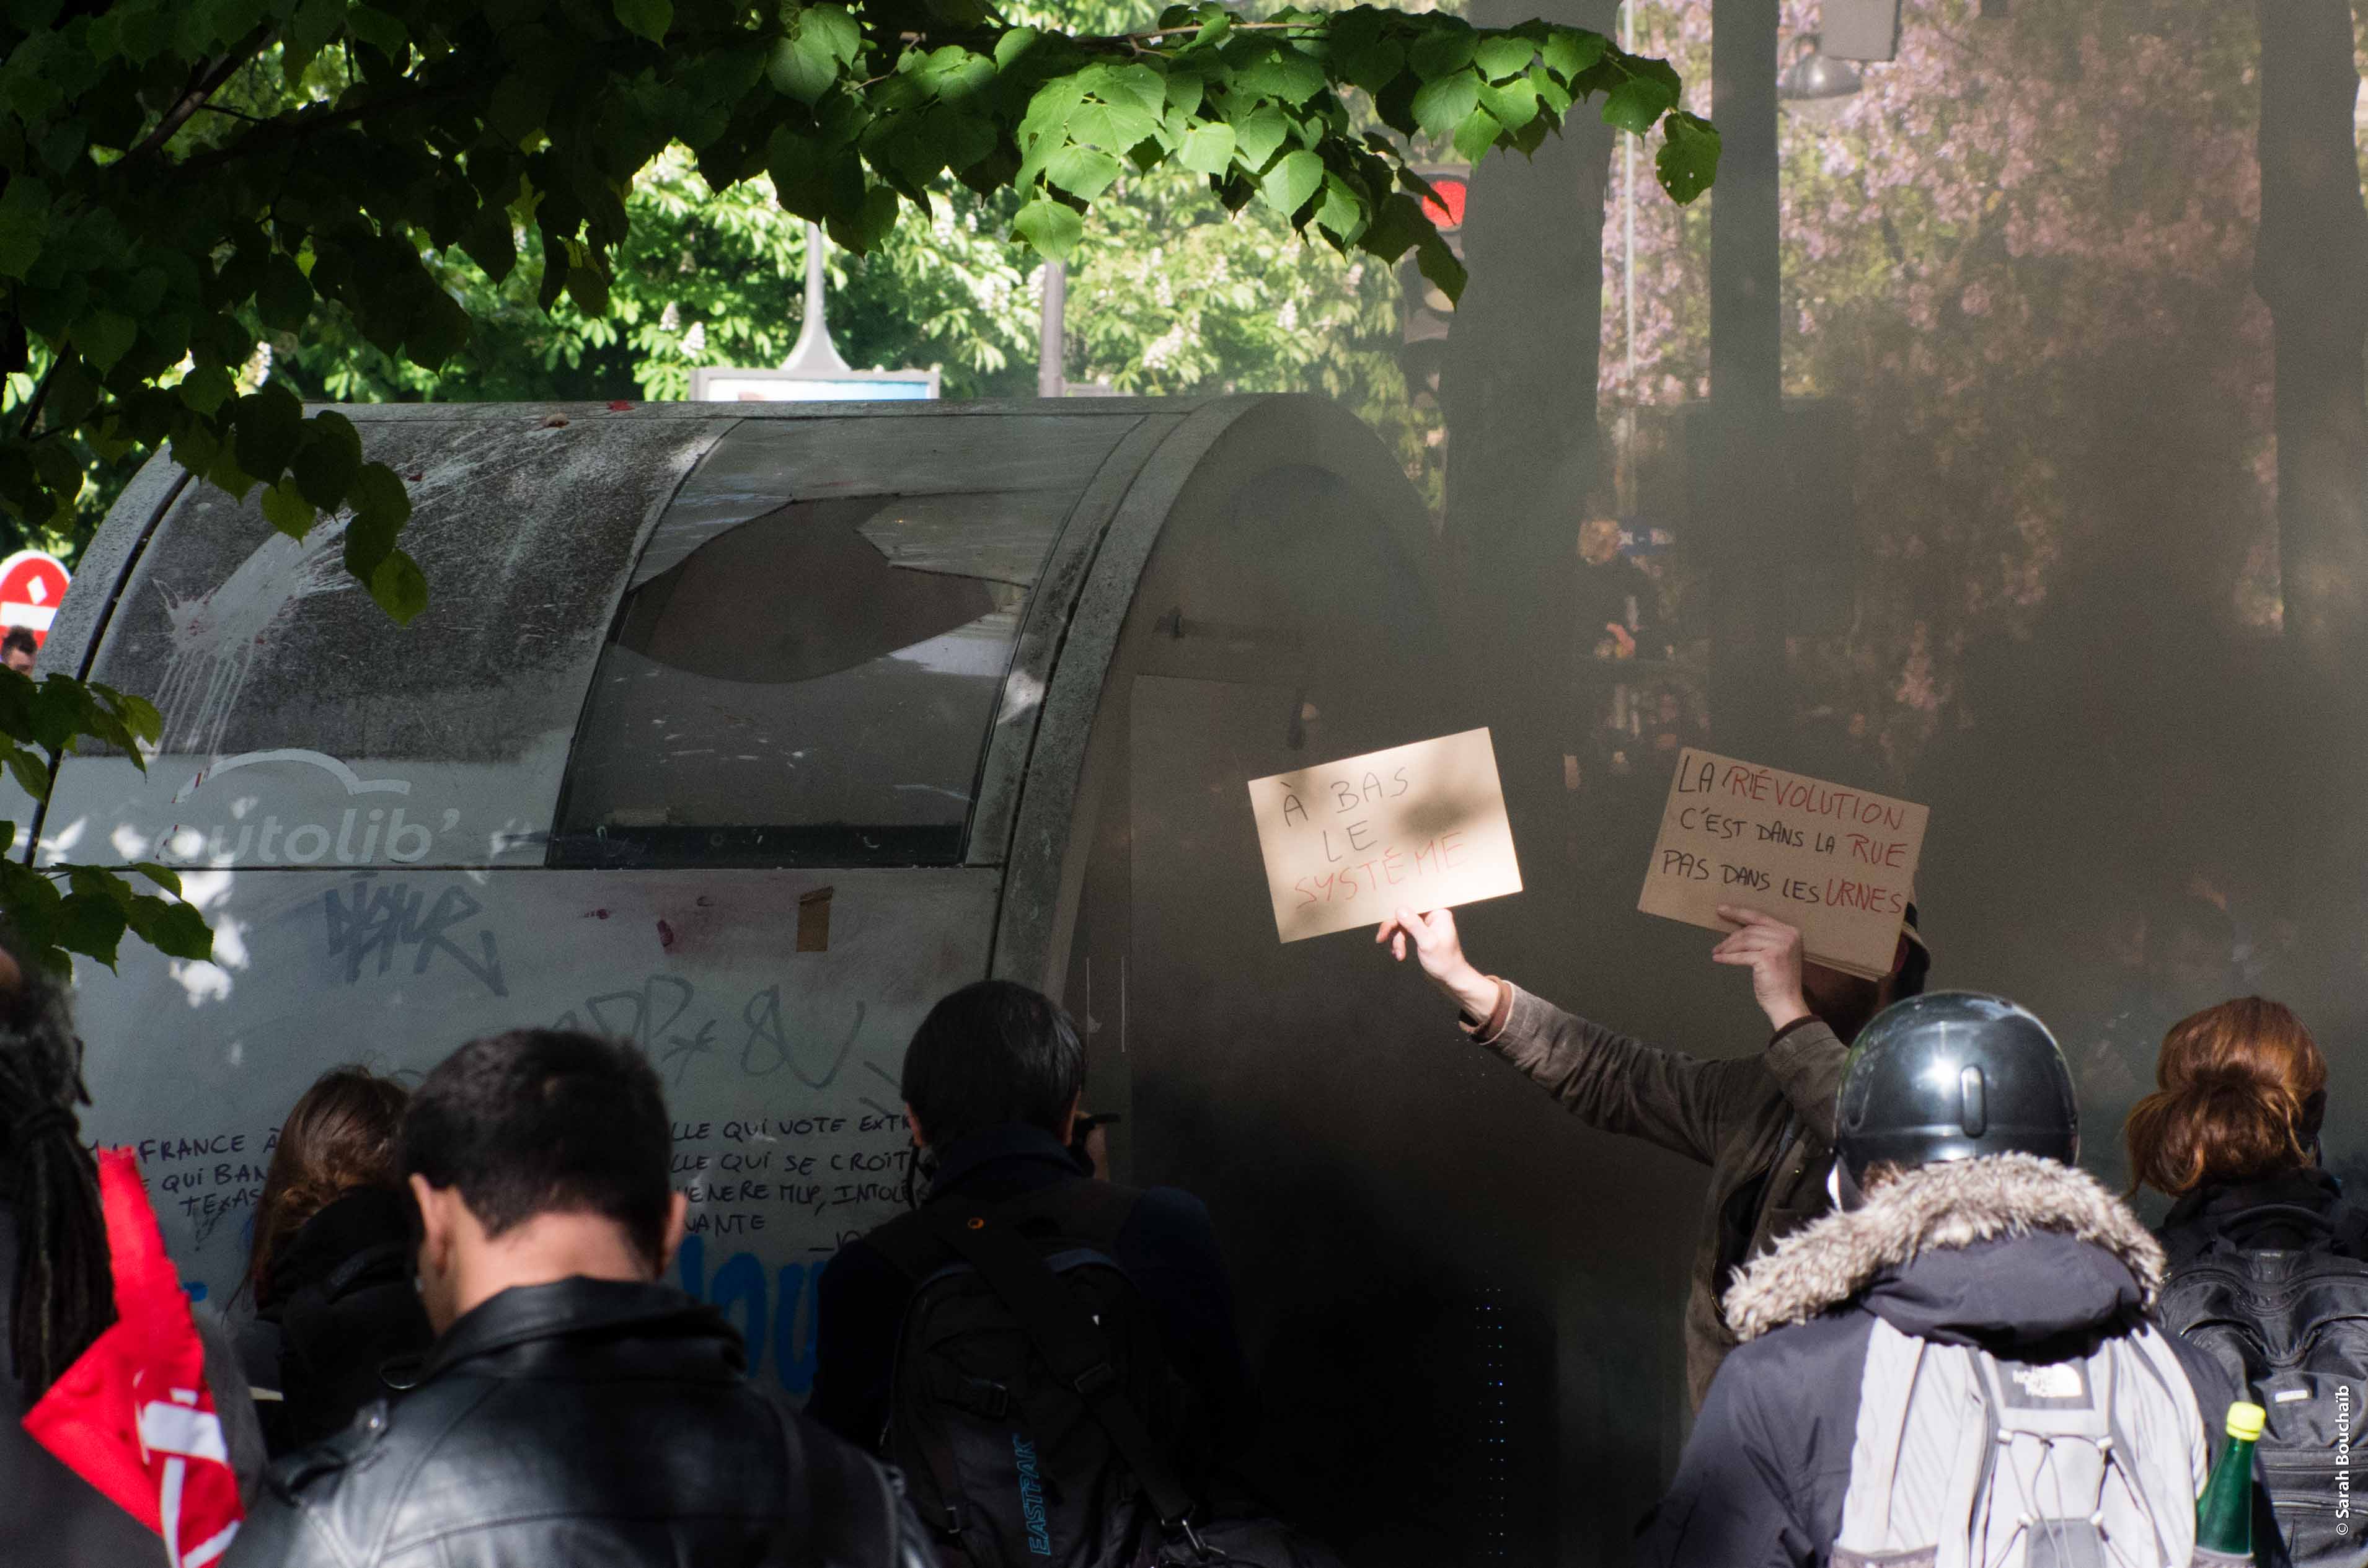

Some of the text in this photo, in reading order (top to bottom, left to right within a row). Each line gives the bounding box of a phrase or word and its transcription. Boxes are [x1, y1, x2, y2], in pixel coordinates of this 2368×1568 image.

[1679, 755, 1715, 793] LA
[1280, 767, 1408, 827] À BAS
[1323, 820, 1378, 863] LE
[1681, 807, 1908, 868] C'EST DANS LA RUE
[1663, 850, 1902, 914] PAS DANS LES URNES
[779, 1117, 847, 1135] VOTE
[138, 1134, 245, 1164] FRANCE
[784, 1155, 818, 1176] SE
[1011, 1432, 1052, 1556] EASTPAK
